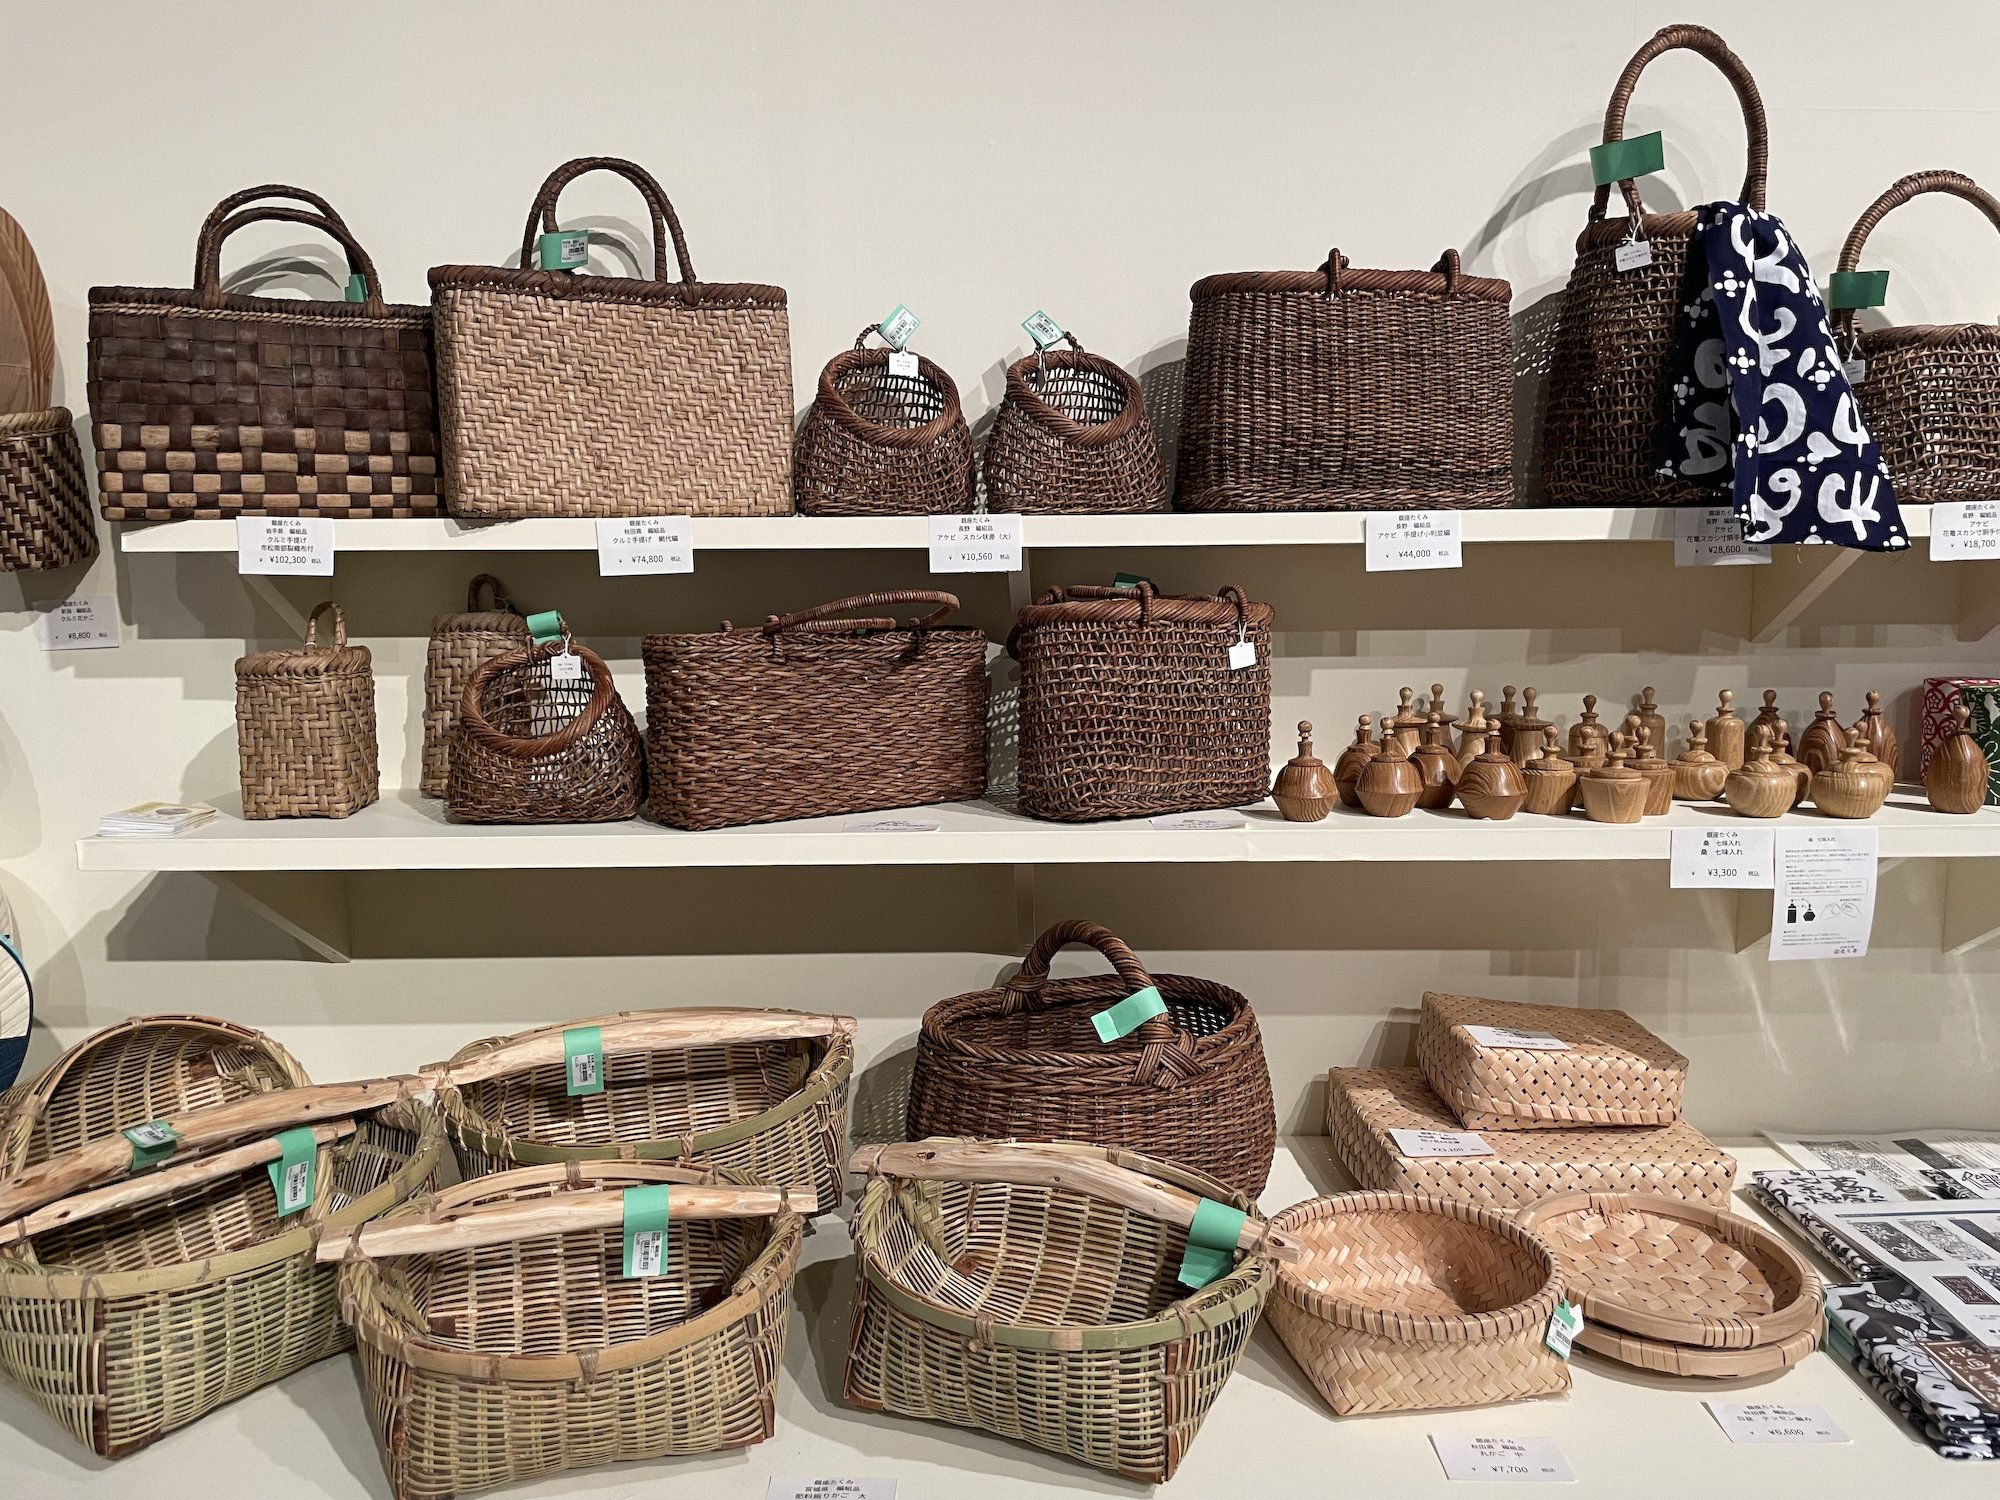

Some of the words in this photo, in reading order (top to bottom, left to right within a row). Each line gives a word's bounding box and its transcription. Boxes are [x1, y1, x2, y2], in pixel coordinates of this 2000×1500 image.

[1708, 509, 1733, 517] 銀座たく
[1969, 520, 1990, 528] アケビ
[1377, 531, 1397, 539] アケビ
[1963, 539, 1996, 549] ¥18,700
[1398, 549, 1431, 559] ¥44,000
[1708, 545, 1741, 555] ¥28,600
[269, 555, 307, 565] ¥102,300
[631, 555, 664, 564] ¥74,800
[960, 552, 993, 562] ¥10,560
[1714, 848, 1744, 856] 七味入れ
[1707, 868, 1738, 878] ¥3,300
[1490, 1465, 1529, 1474] ¥7,700
